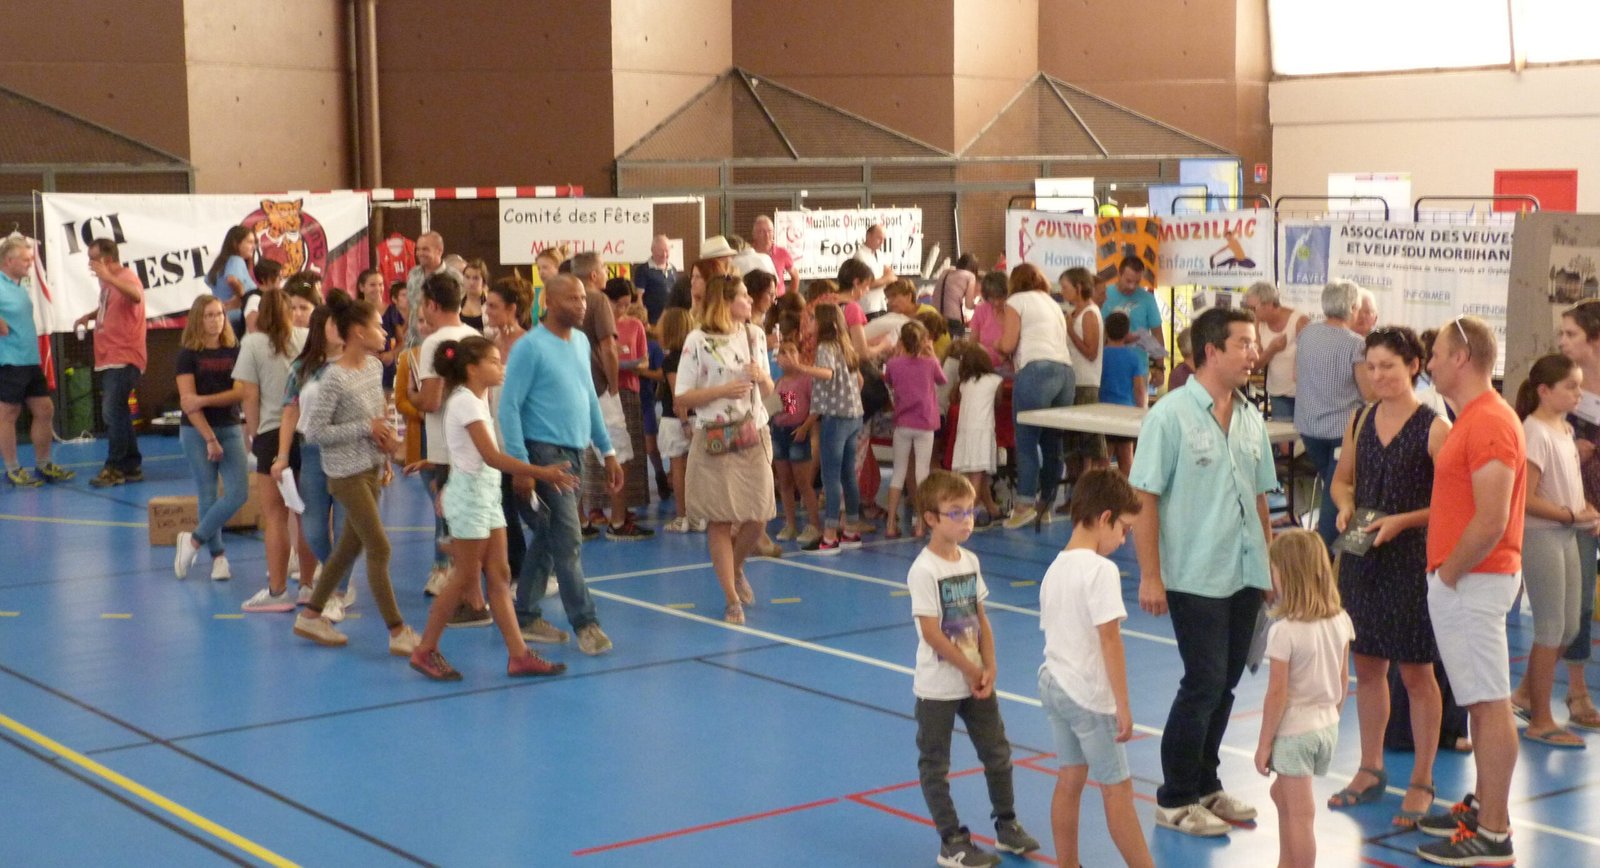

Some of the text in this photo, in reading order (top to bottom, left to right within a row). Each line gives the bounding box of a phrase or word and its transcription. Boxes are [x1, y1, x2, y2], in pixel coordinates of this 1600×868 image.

[503, 206, 650, 224] Comité des Fêtes
[806, 214, 841, 229] Muzillac
[880, 213, 902, 229] Sport
[62, 213, 127, 255] ICI
[1035, 218, 1256, 242] CULTUR MUZILLAC
[1431, 230, 1460, 244] DES
[820, 238, 892, 256] Footll
[1347, 241, 1361, 254] ET
[1429, 247, 1510, 261] MORBIHAN
[122, 245, 209, 289] EST
[1158, 254, 1205, 269] Enfants
